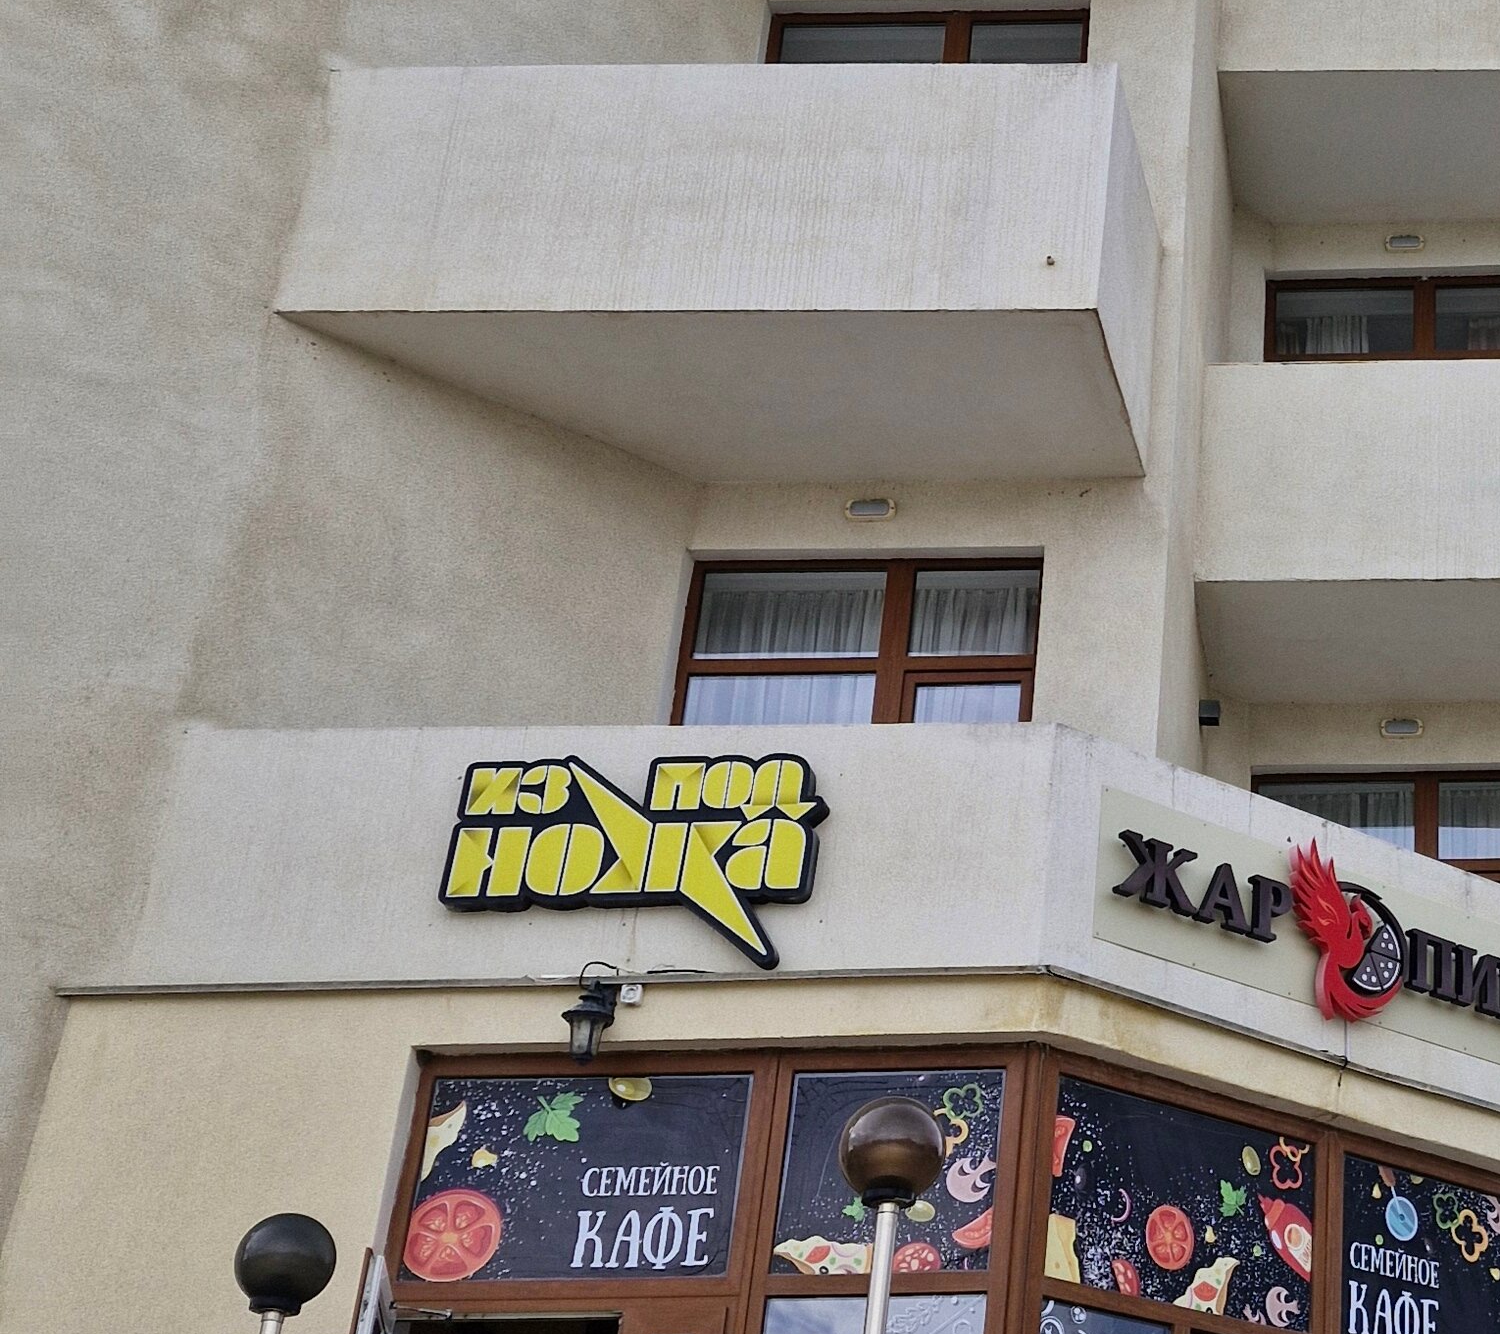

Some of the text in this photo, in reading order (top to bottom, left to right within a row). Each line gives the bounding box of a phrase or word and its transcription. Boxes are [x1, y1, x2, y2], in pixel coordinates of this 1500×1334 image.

[1112, 829, 1293, 943] ЖАР
[582, 1162, 720, 1197] СЕМЕЙНОЕ
[570, 1206, 715, 1270] КАФЕ
[1349, 1241, 1440, 1289] СЕМЕЙНОЕ
